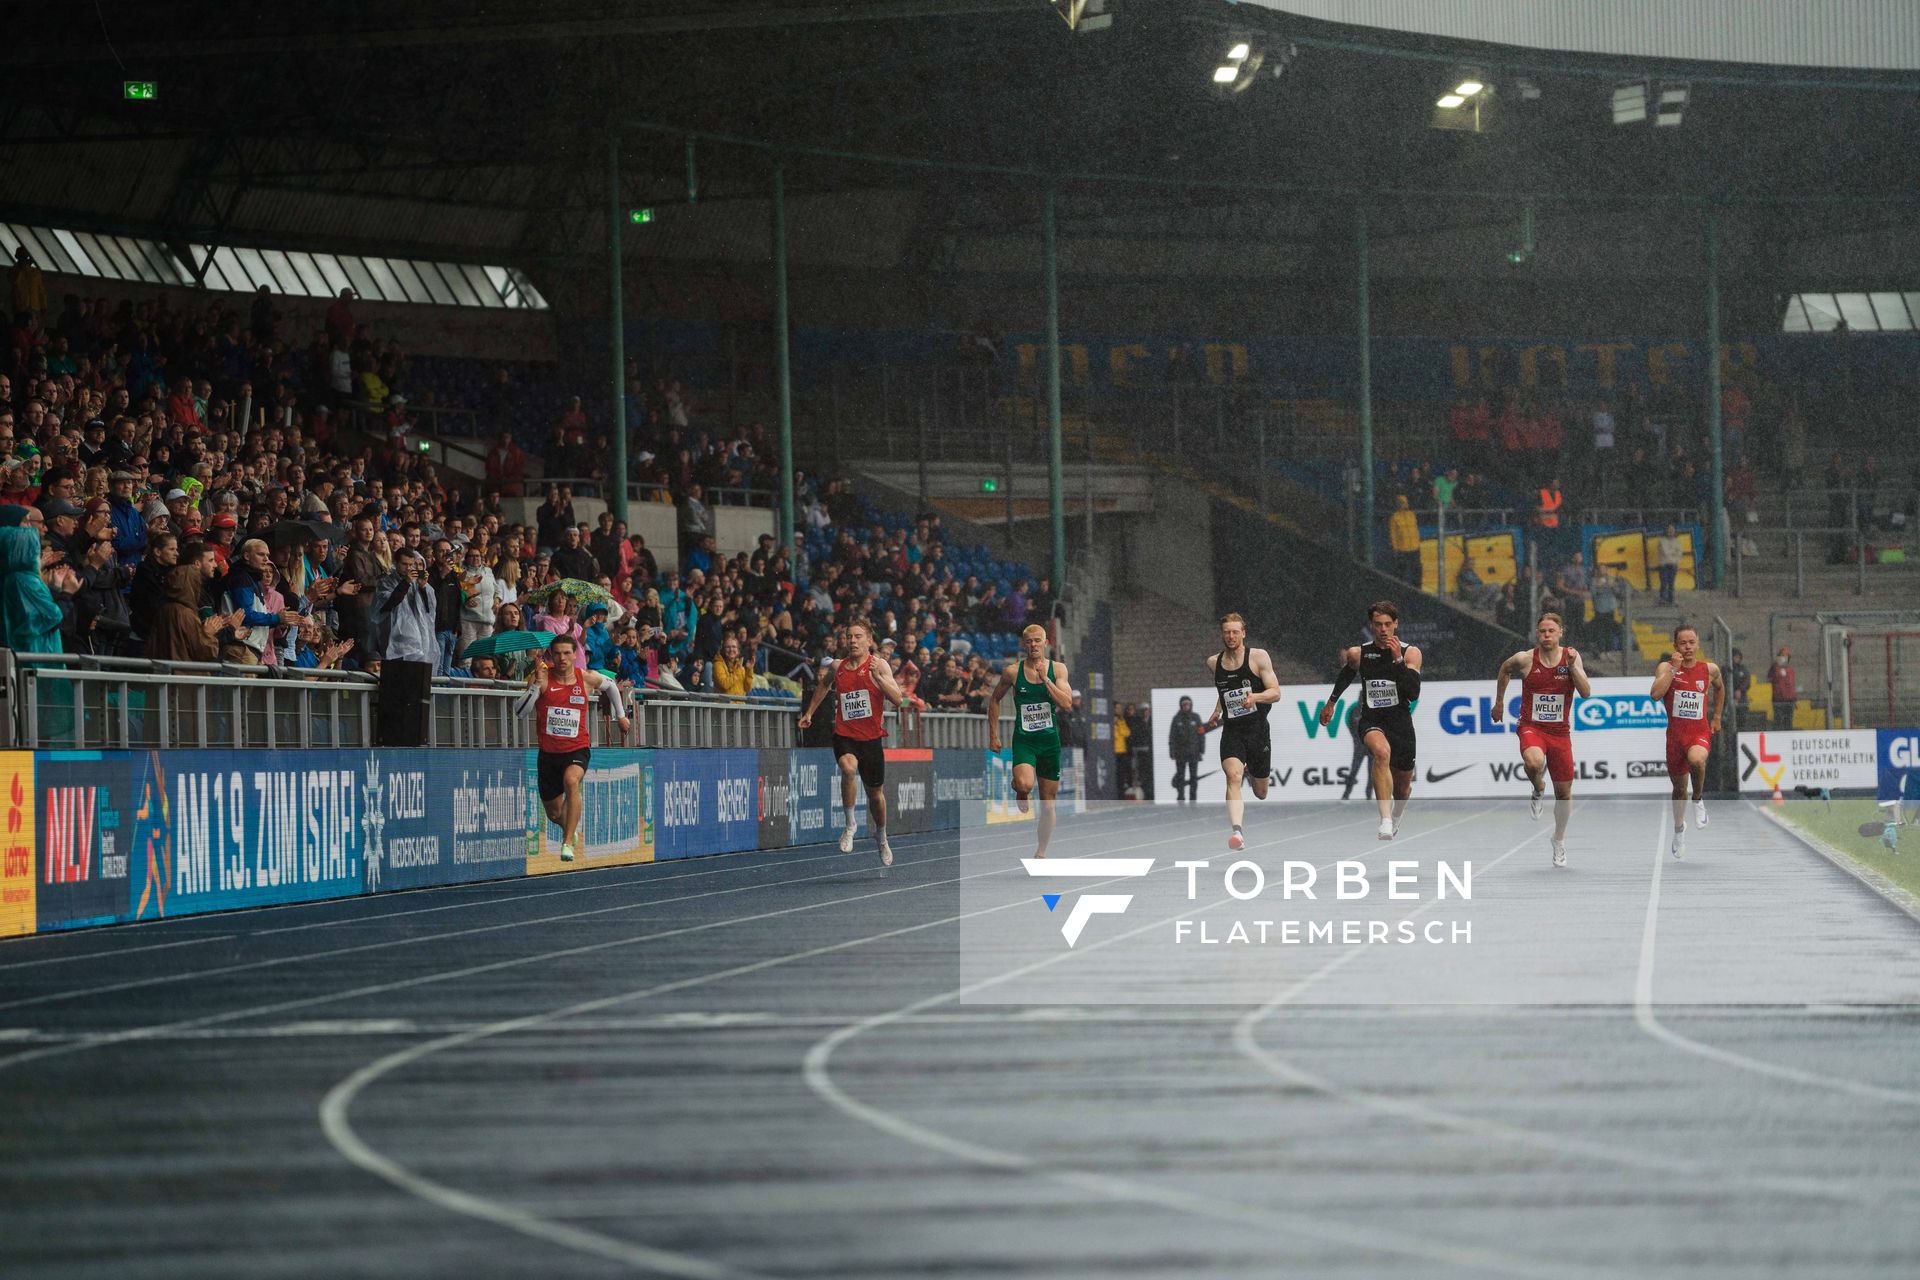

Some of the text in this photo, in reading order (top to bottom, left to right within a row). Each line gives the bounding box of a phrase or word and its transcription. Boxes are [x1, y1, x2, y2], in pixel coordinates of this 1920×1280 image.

[846, 691, 860, 699] GLS
[1229, 690, 1243, 698] GLS
[1368, 689, 1396, 698] HORSTMANN
[1681, 691, 1696, 699] GLS
[845, 700, 867, 710] FINKE
[1535, 704, 1561, 712] WELLM
[1678, 701, 1699, 710] JAHN
[549, 717, 578, 727] REDDEMANN
[1792, 738, 1850, 750] DEUTSCHER
[1792, 753, 1875, 766] LEICHTATHLETIK
[1793, 768, 1840, 780] VERBAND
[389, 771, 425, 820] POLIZEI
[45, 786, 97, 884] NLV
[177, 770, 355, 895] AM 1.9. ZUM ISTAF!
[389, 835, 440, 868] NIEDERSACHSEN
[4, 847, 30, 878] LOTTO
